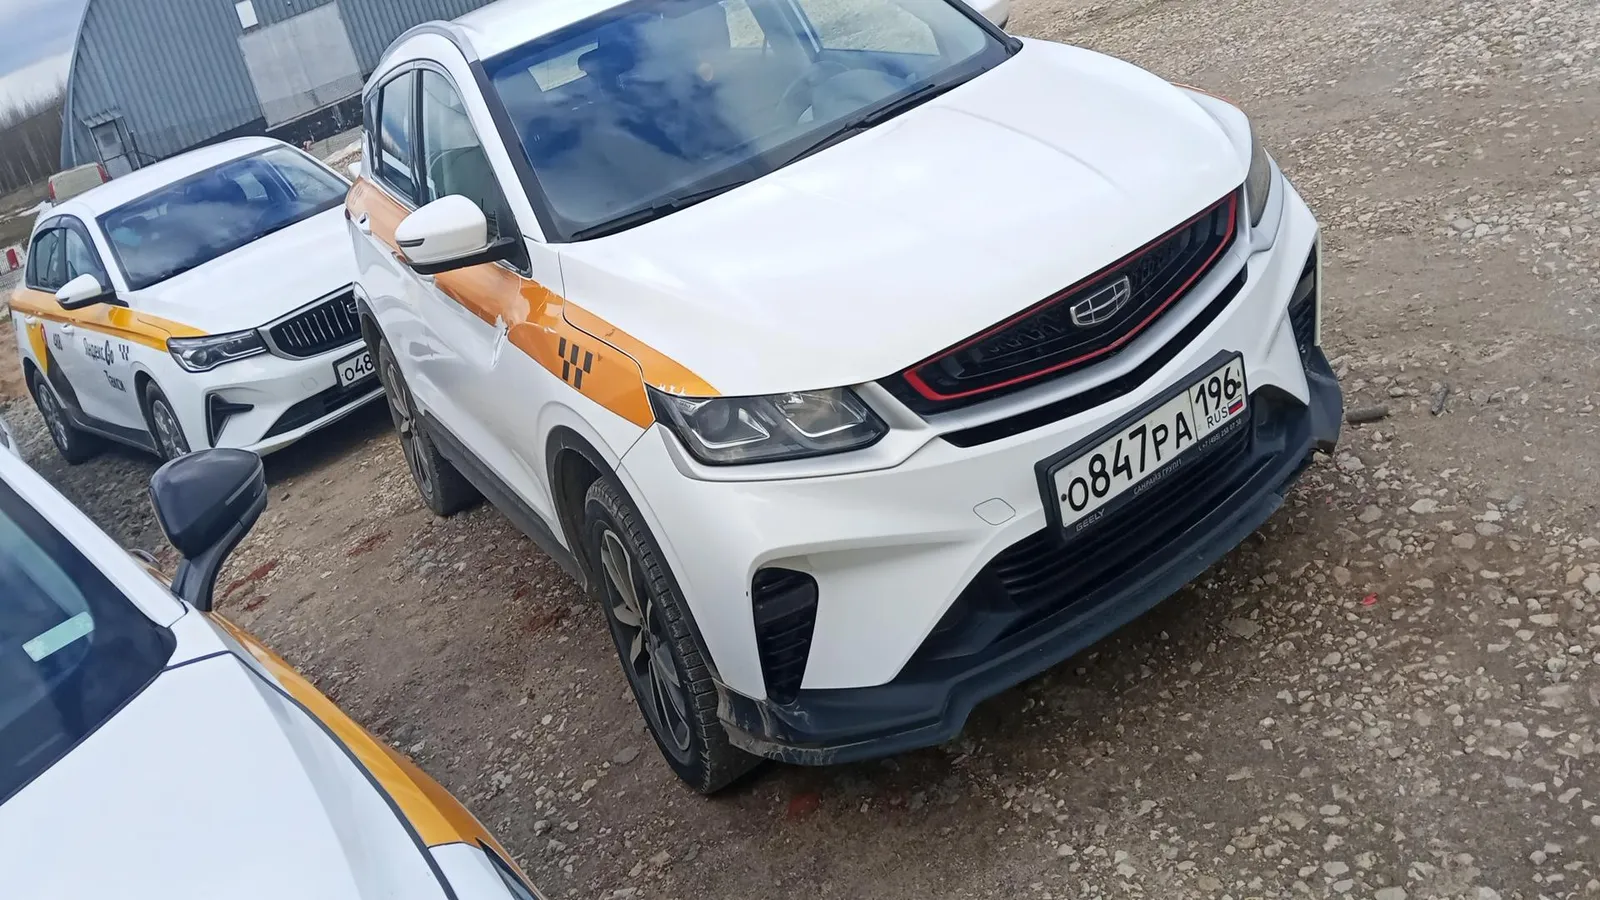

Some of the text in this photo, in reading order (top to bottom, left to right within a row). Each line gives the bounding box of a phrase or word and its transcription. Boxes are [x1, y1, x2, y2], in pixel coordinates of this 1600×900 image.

[1195, 367, 1237, 416] 196
[1207, 407, 1228, 429] RUS
[1162, 458, 1182, 477] ГРУПП
[1076, 508, 1105, 531] GEELY
